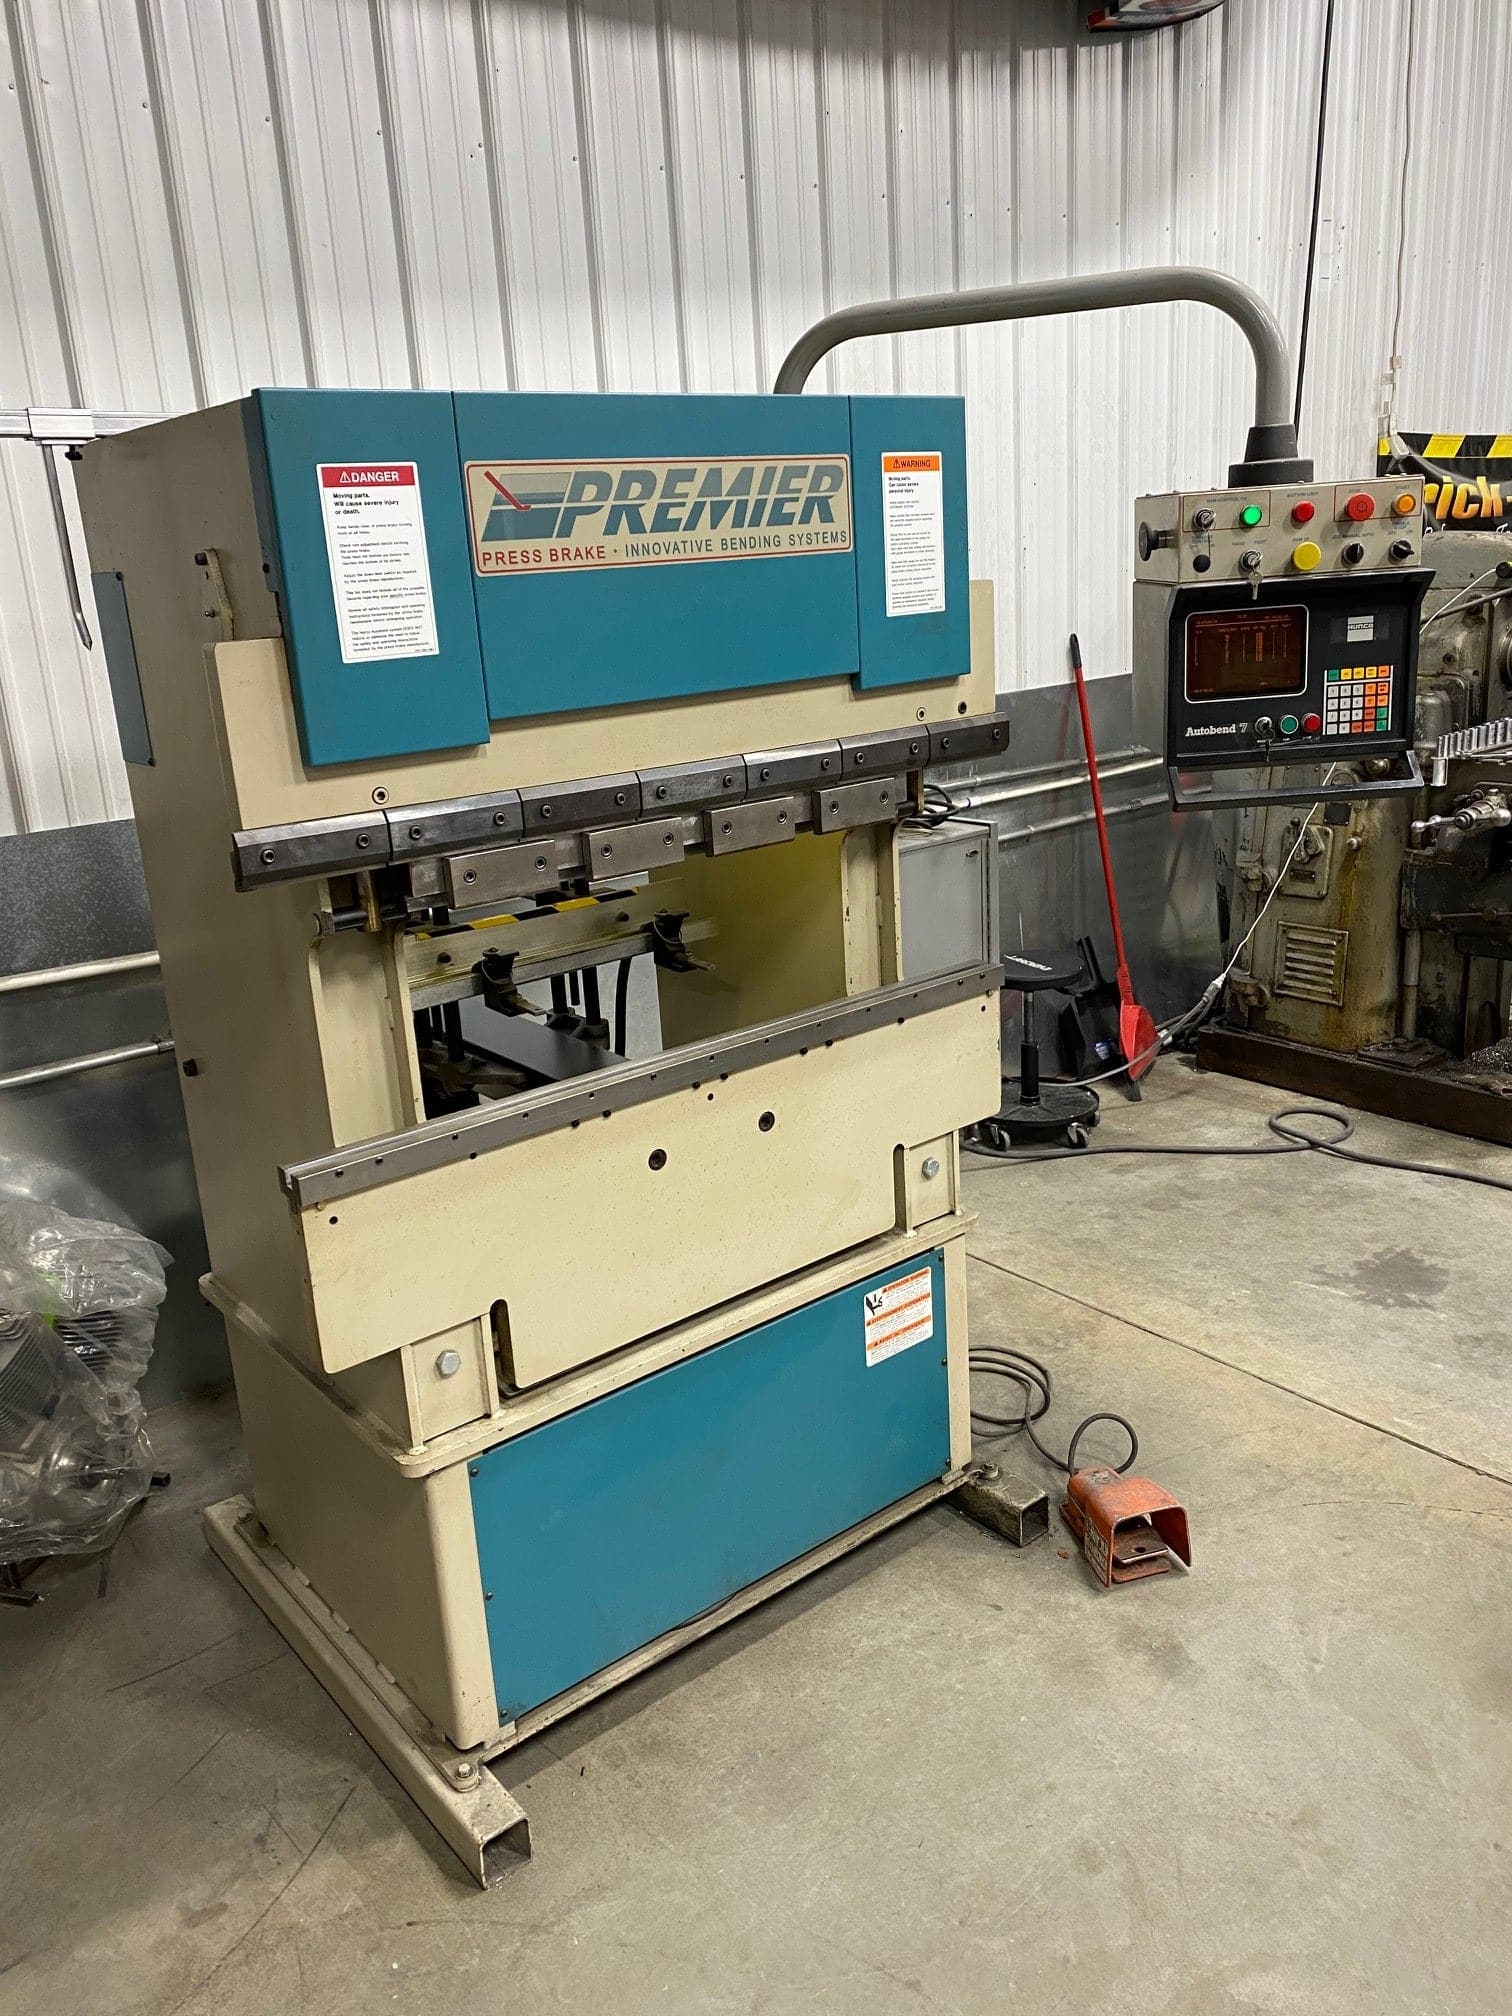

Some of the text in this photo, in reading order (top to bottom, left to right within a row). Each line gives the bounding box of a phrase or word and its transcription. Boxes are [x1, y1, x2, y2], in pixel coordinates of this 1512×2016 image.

[900, 460, 931, 468] WARNING
[351, 471, 400, 483] DANGER
[333, 492, 370, 500] Moving parts.
[555, 464, 844, 538] PREMIER
[384, 499, 399, 507] injury
[482, 530, 847, 567] PRESS BRAKE INNOVATIVE BENDING SYSTEMS
[1185, 722, 1248, 737] Autobend 7
